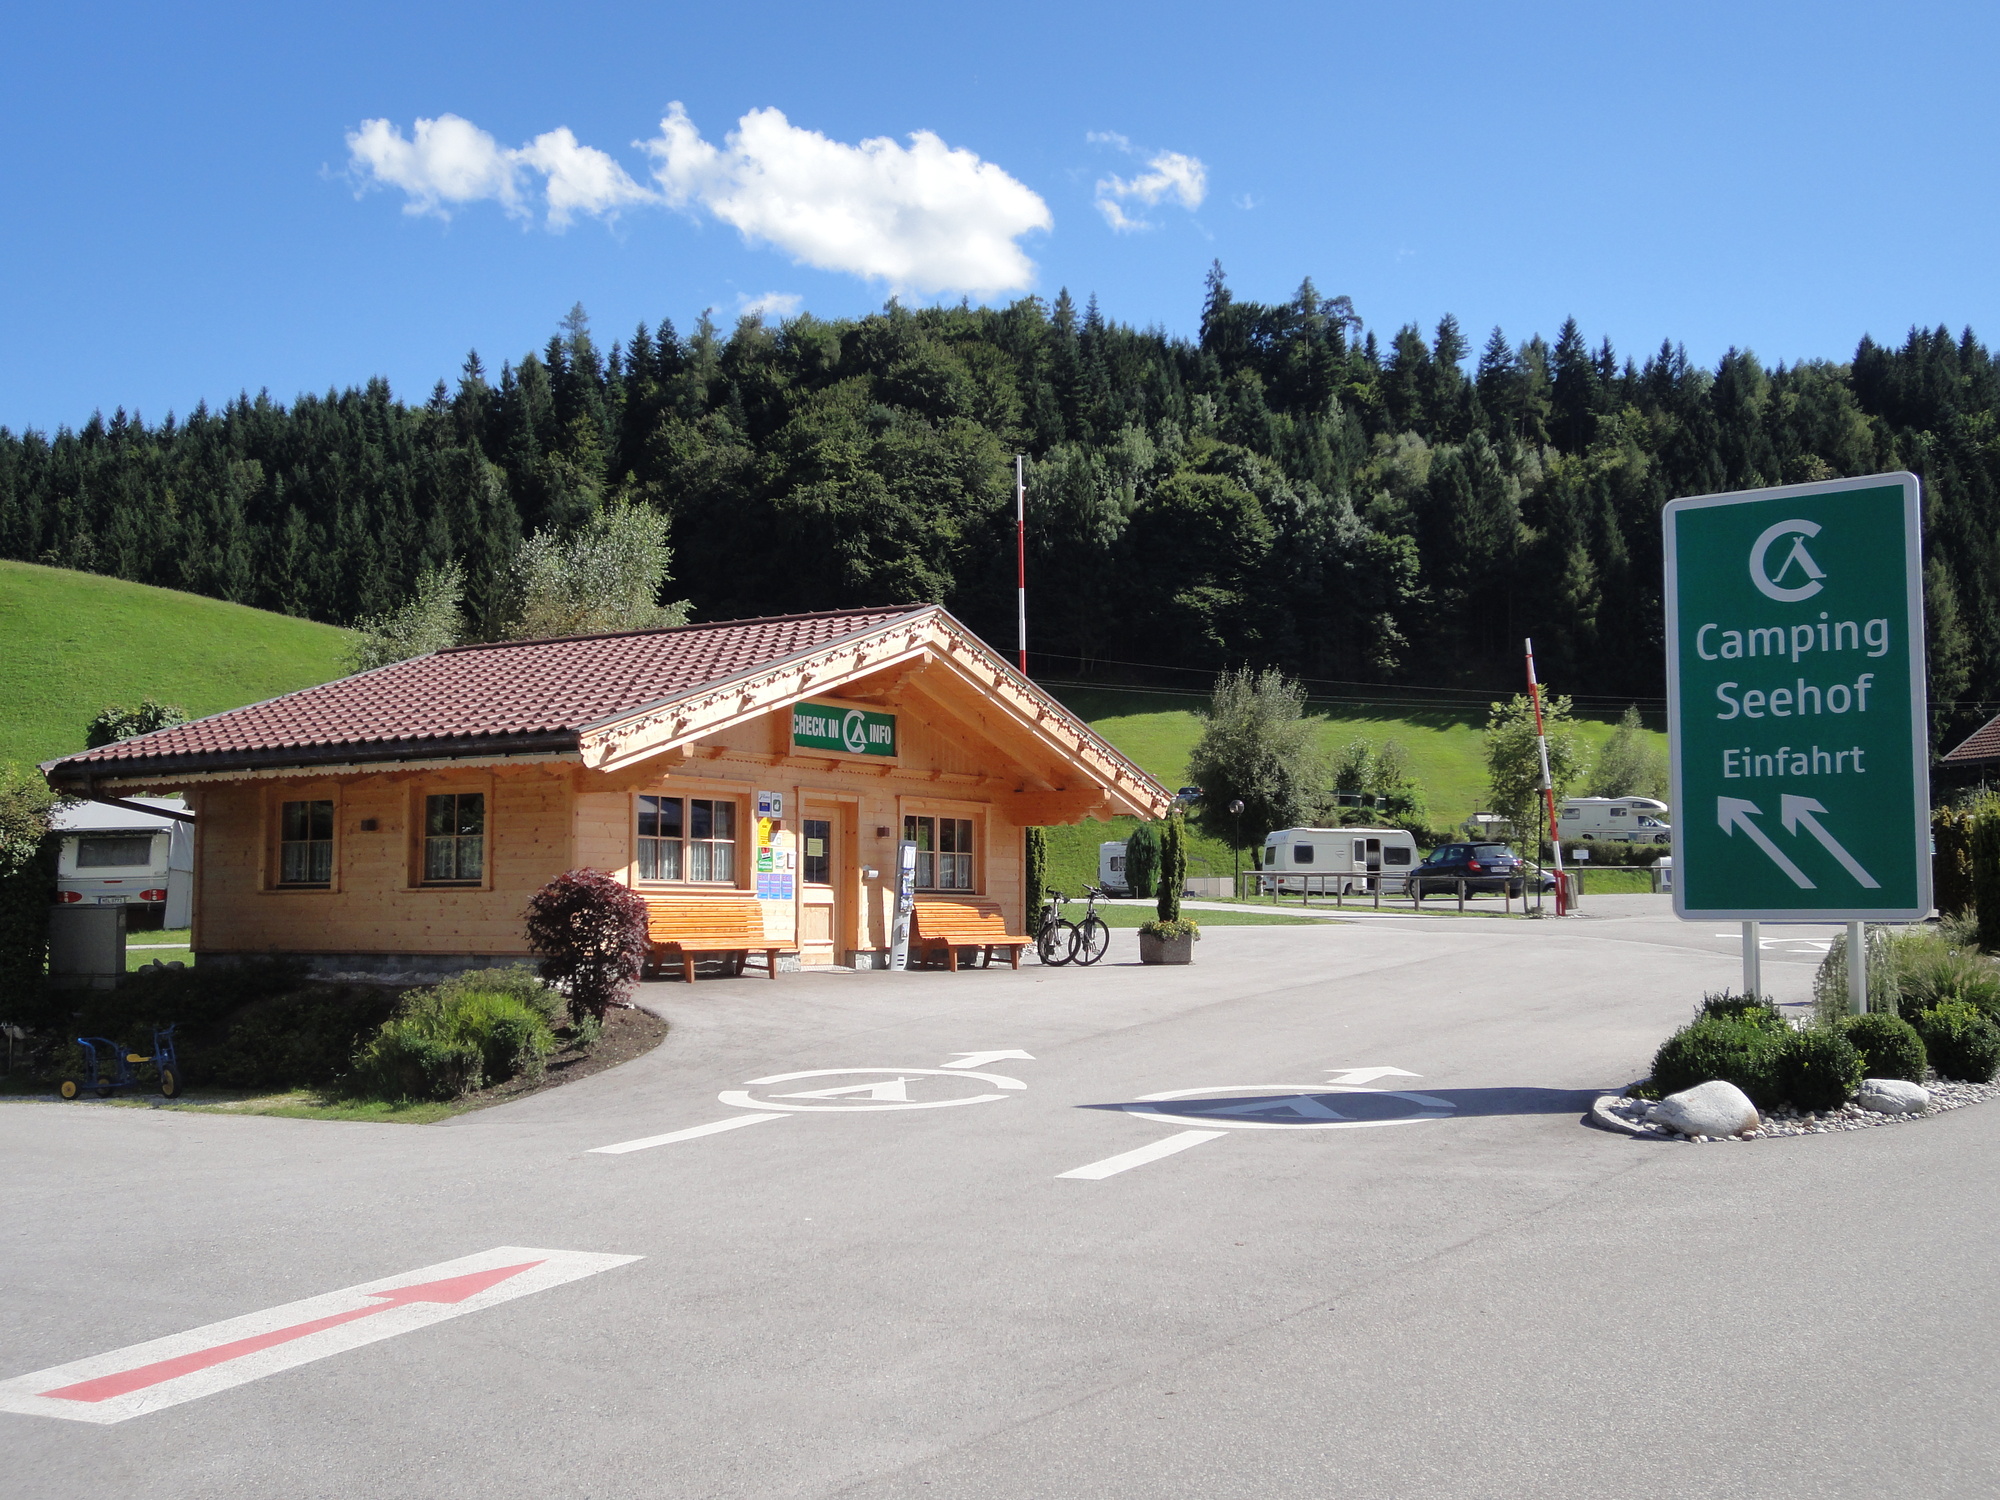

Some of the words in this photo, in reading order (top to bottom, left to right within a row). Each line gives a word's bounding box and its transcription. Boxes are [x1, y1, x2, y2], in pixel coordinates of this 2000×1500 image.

[1696, 611, 1889, 663] Camping
[1716, 673, 1875, 720] Seehof
[793, 714, 826, 738] CHECK
[828, 719, 839, 738] IN
[869, 724, 891, 744] INFO
[1723, 744, 1866, 779] Einfahrt
